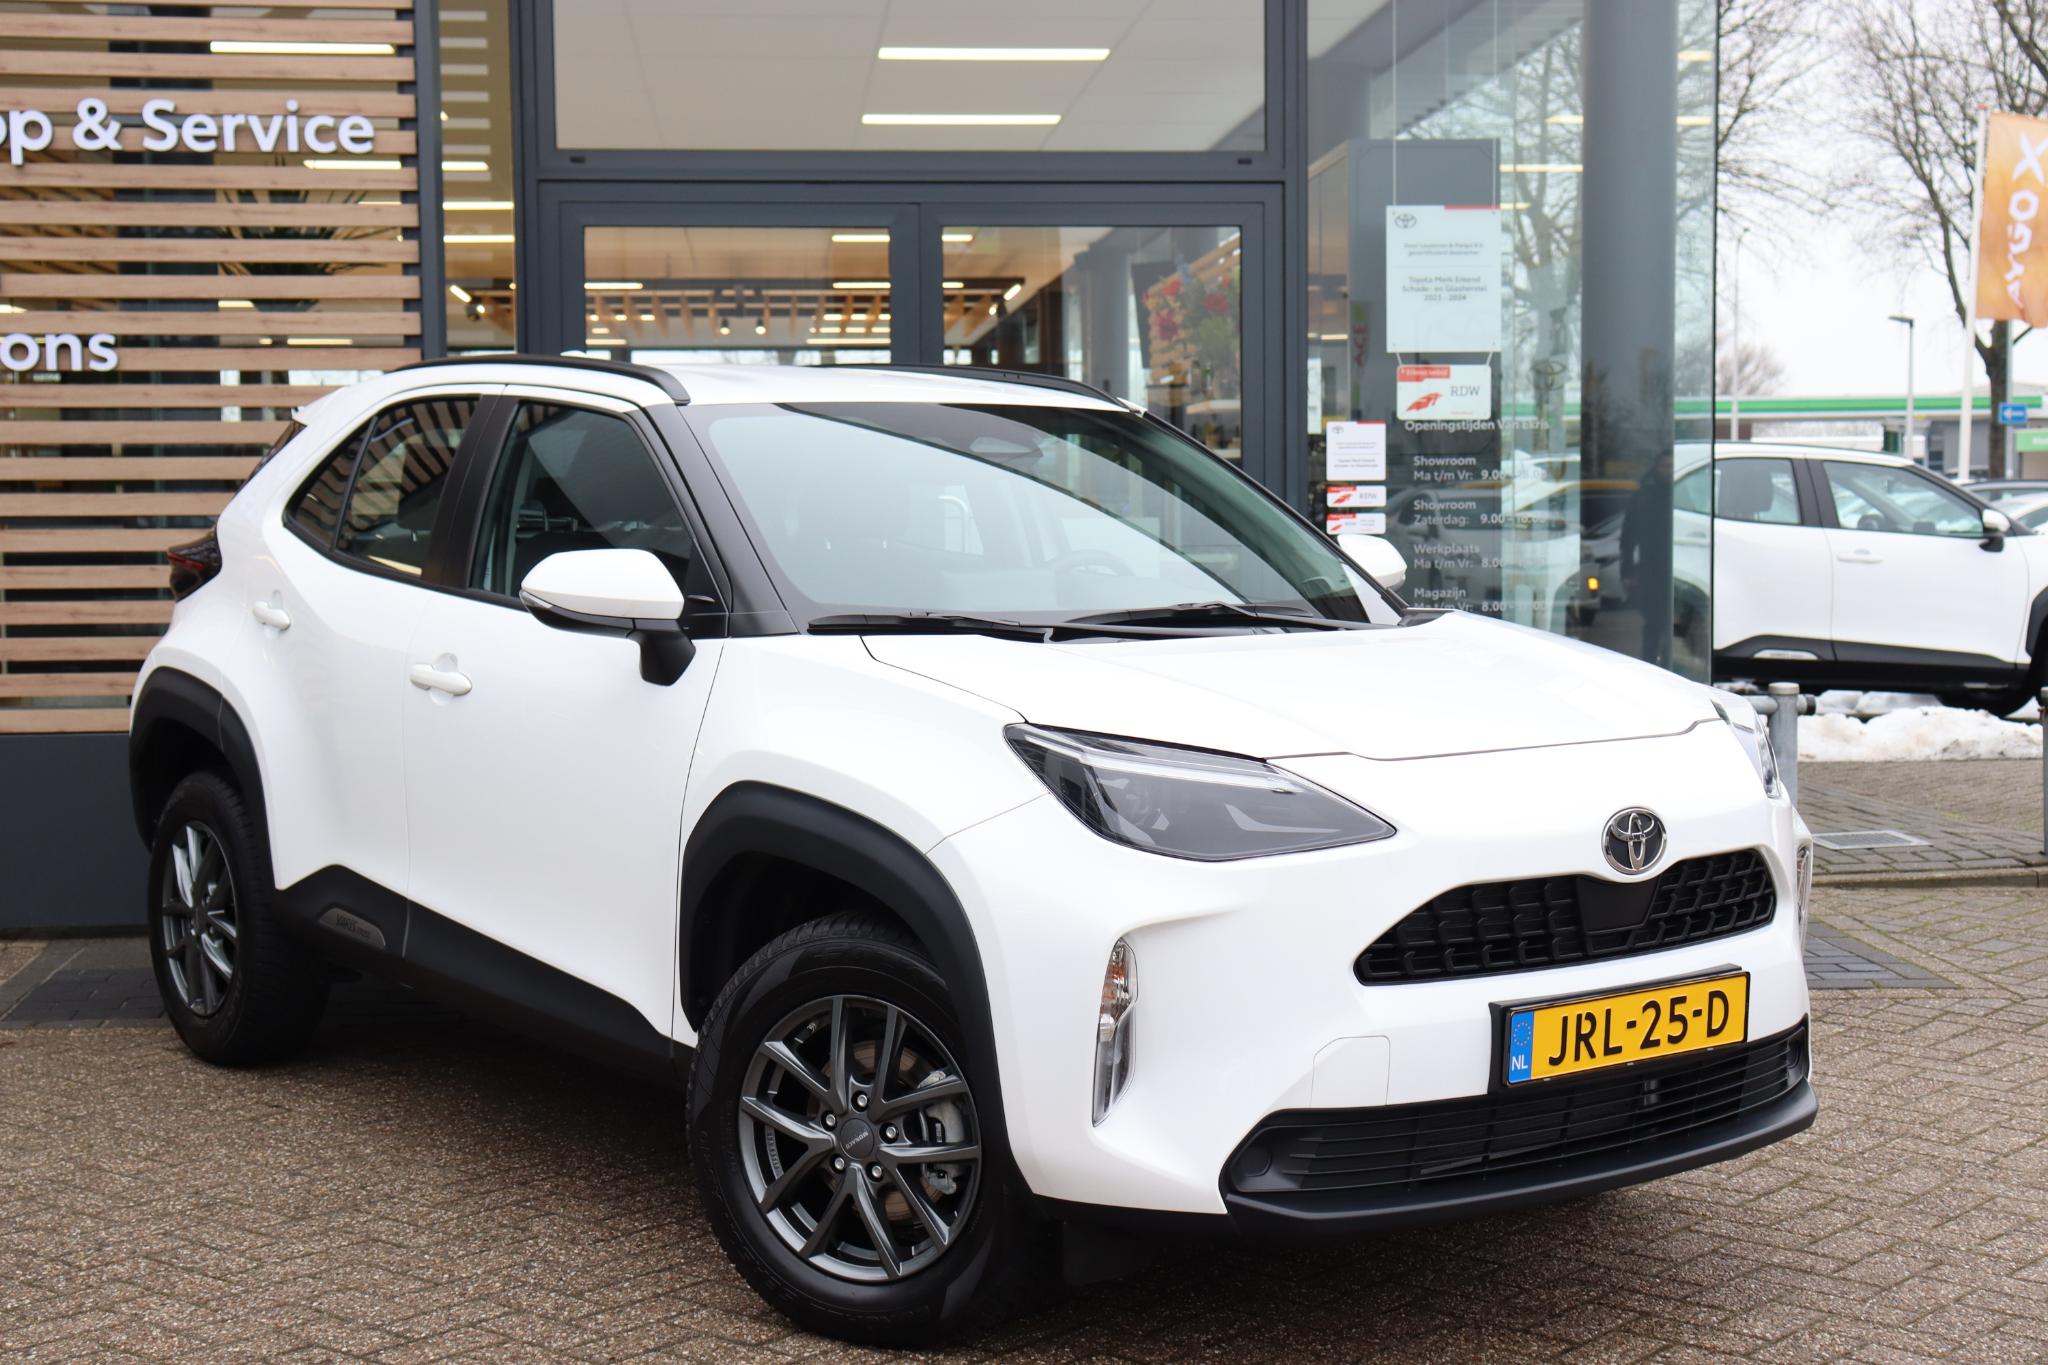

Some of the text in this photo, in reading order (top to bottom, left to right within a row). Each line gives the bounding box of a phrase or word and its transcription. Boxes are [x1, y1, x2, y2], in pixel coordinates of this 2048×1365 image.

[72, 98, 123, 152] &
[142, 98, 375, 153] Service
[2004, 131, 2048, 308] AYGO X
[0, 332, 119, 372] ons
[1450, 386, 1481, 397] RDW
[1405, 420, 1495, 432] Openingstijden
[1413, 456, 1477, 466] Showroom
[1414, 471, 1431, 481] Ma
[1434, 470, 1455, 481] t/m
[1457, 471, 1473, 481] Vr:
[1481, 470, 1505, 481] 9.00
[1413, 500, 1477, 510] Showroom
[1414, 514, 1469, 527] Zaterdag:
[1480, 513, 1505, 525] 9.00
[1414, 544, 1480, 556] Werkplaats
[1414, 559, 1431, 569] Ma
[1434, 558, 1455, 569] t/m
[1459, 559, 1473, 569] Vr:
[1414, 588, 1466, 600] Magazijn
[1481, 601, 1506, 612] 8.00
[1548, 989, 1729, 1066] JRL-25-D
[1511, 1055, 1529, 1072] NL
[845, 1130, 869, 1150] MONACO
